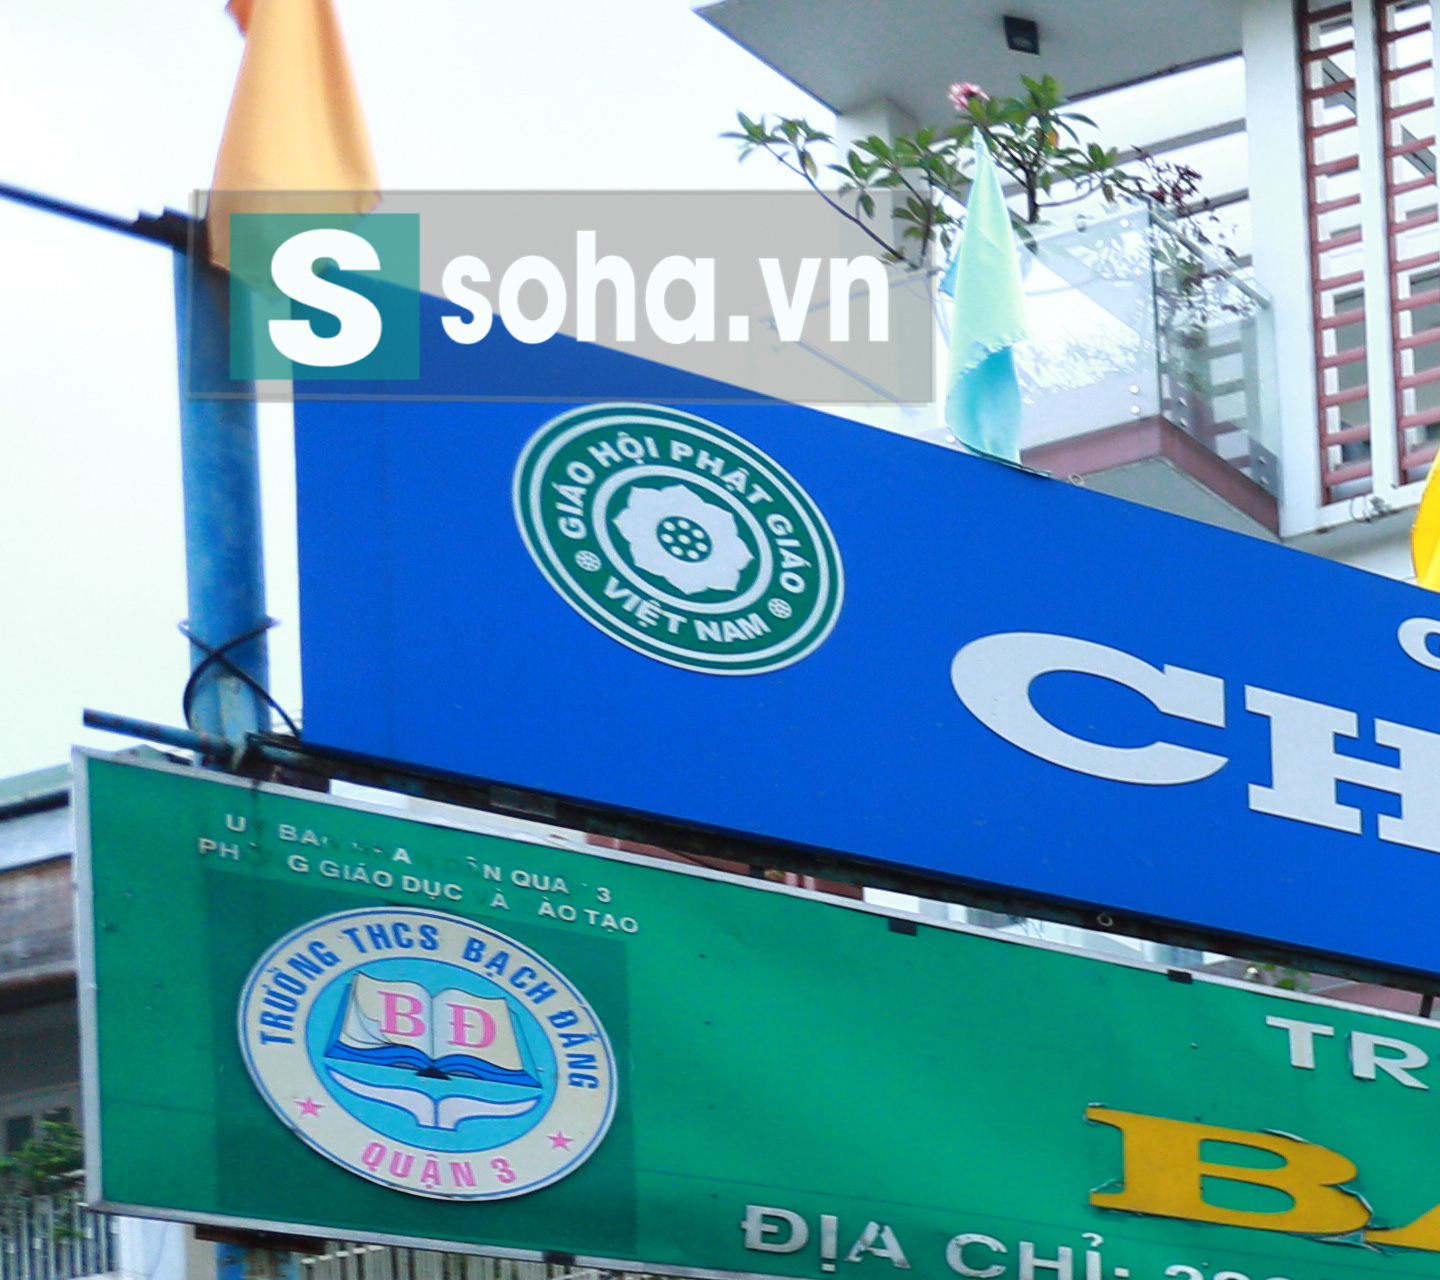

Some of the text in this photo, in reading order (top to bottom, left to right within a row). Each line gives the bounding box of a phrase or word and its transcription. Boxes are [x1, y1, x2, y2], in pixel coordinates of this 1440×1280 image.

[556, 431, 812, 594] GIÁO HỘI PHẬT GIÁO
[603, 576, 772, 643] VIỆT NAM
[318, 860, 395, 889] GIÁO
[401, 873, 464, 902] DỤC
[583, 907, 640, 935] TẠO
[258, 938, 341, 1047] TRƯỜNG
[340, 921, 442, 955] THCS
[462, 936, 558, 1007] BẠCH
[360, 1141, 517, 1189] QUẬN 3
[739, 1202, 910, 1273] ĐỊA
